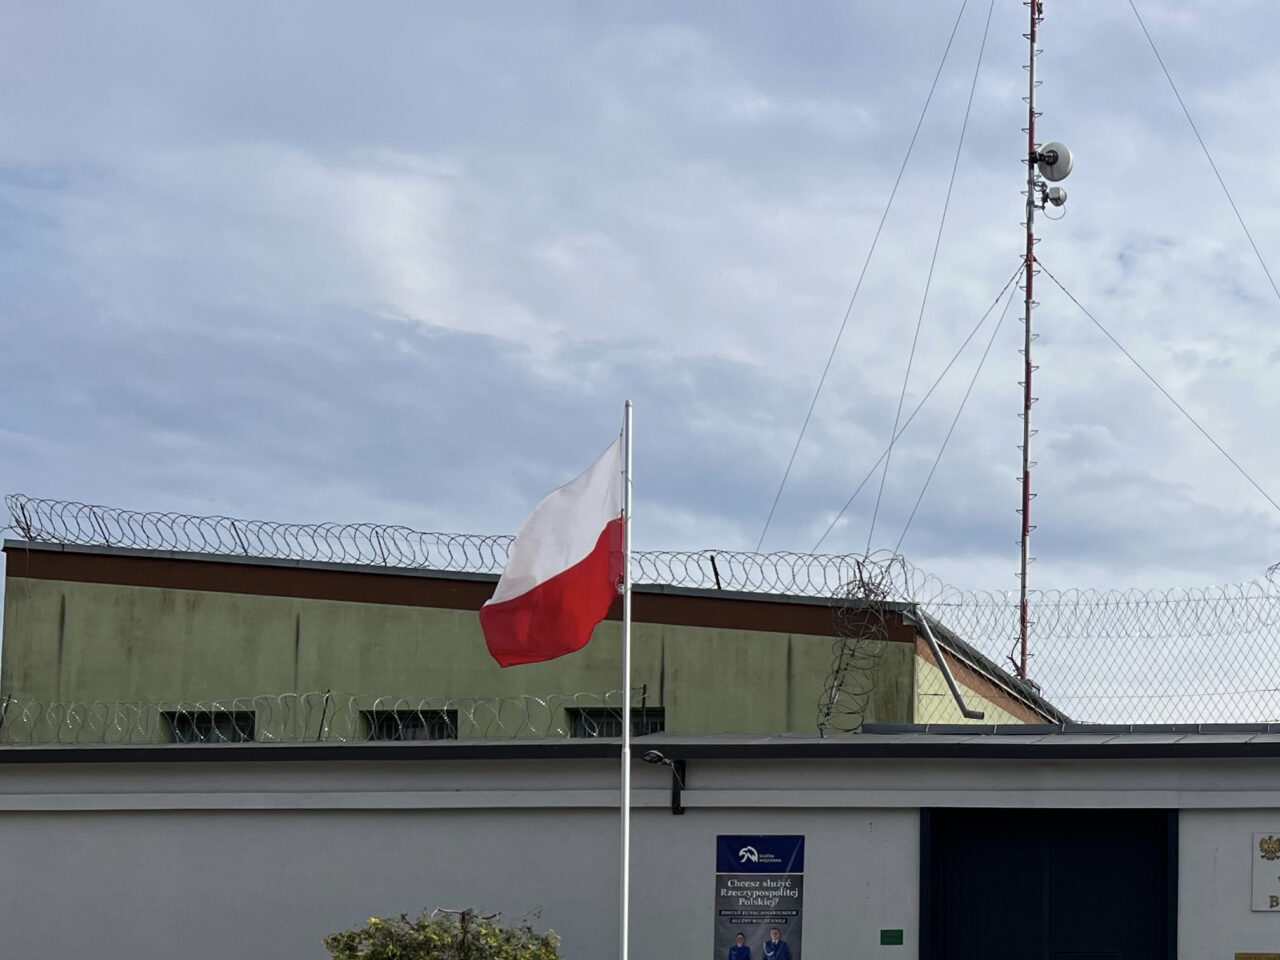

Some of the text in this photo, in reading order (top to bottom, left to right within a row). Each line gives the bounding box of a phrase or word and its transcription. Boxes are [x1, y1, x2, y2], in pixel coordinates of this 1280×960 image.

[728, 879, 792, 889] Chcesz służyć
[720, 888, 799, 898] Rzeczypospolitej
[739, 898, 779, 907] Polskiej?
